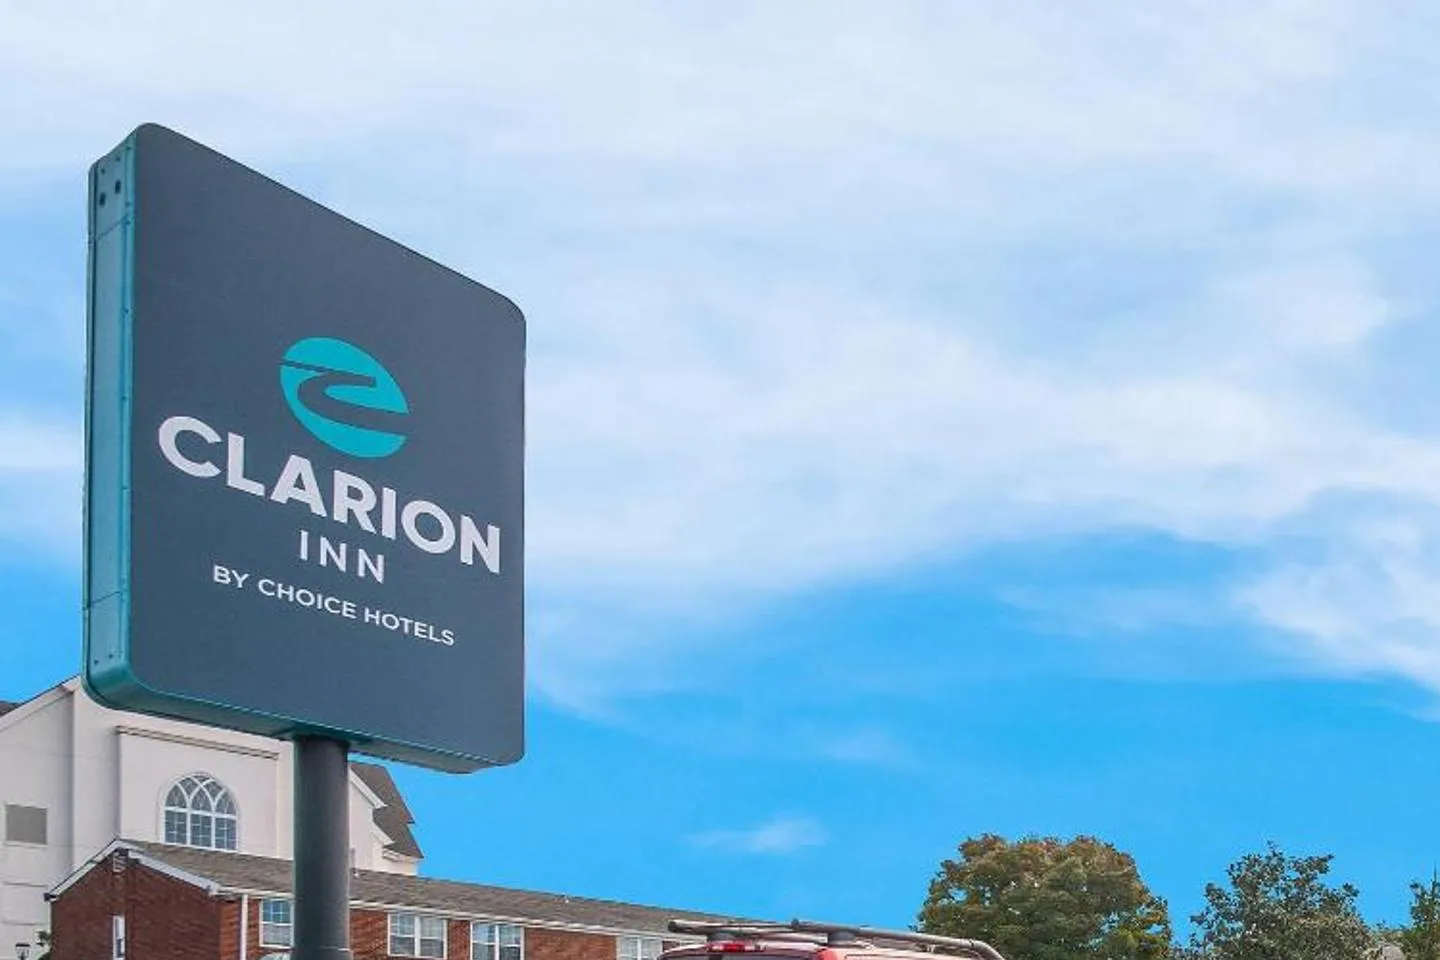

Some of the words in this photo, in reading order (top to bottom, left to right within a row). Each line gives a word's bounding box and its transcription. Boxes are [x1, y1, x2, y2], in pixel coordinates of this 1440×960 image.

[158, 416, 500, 575] CLARION
[300, 529, 384, 584] INN
[213, 565, 249, 588] BY
[258, 579, 358, 619] CHOICE
[364, 607, 455, 646] HOTELS
